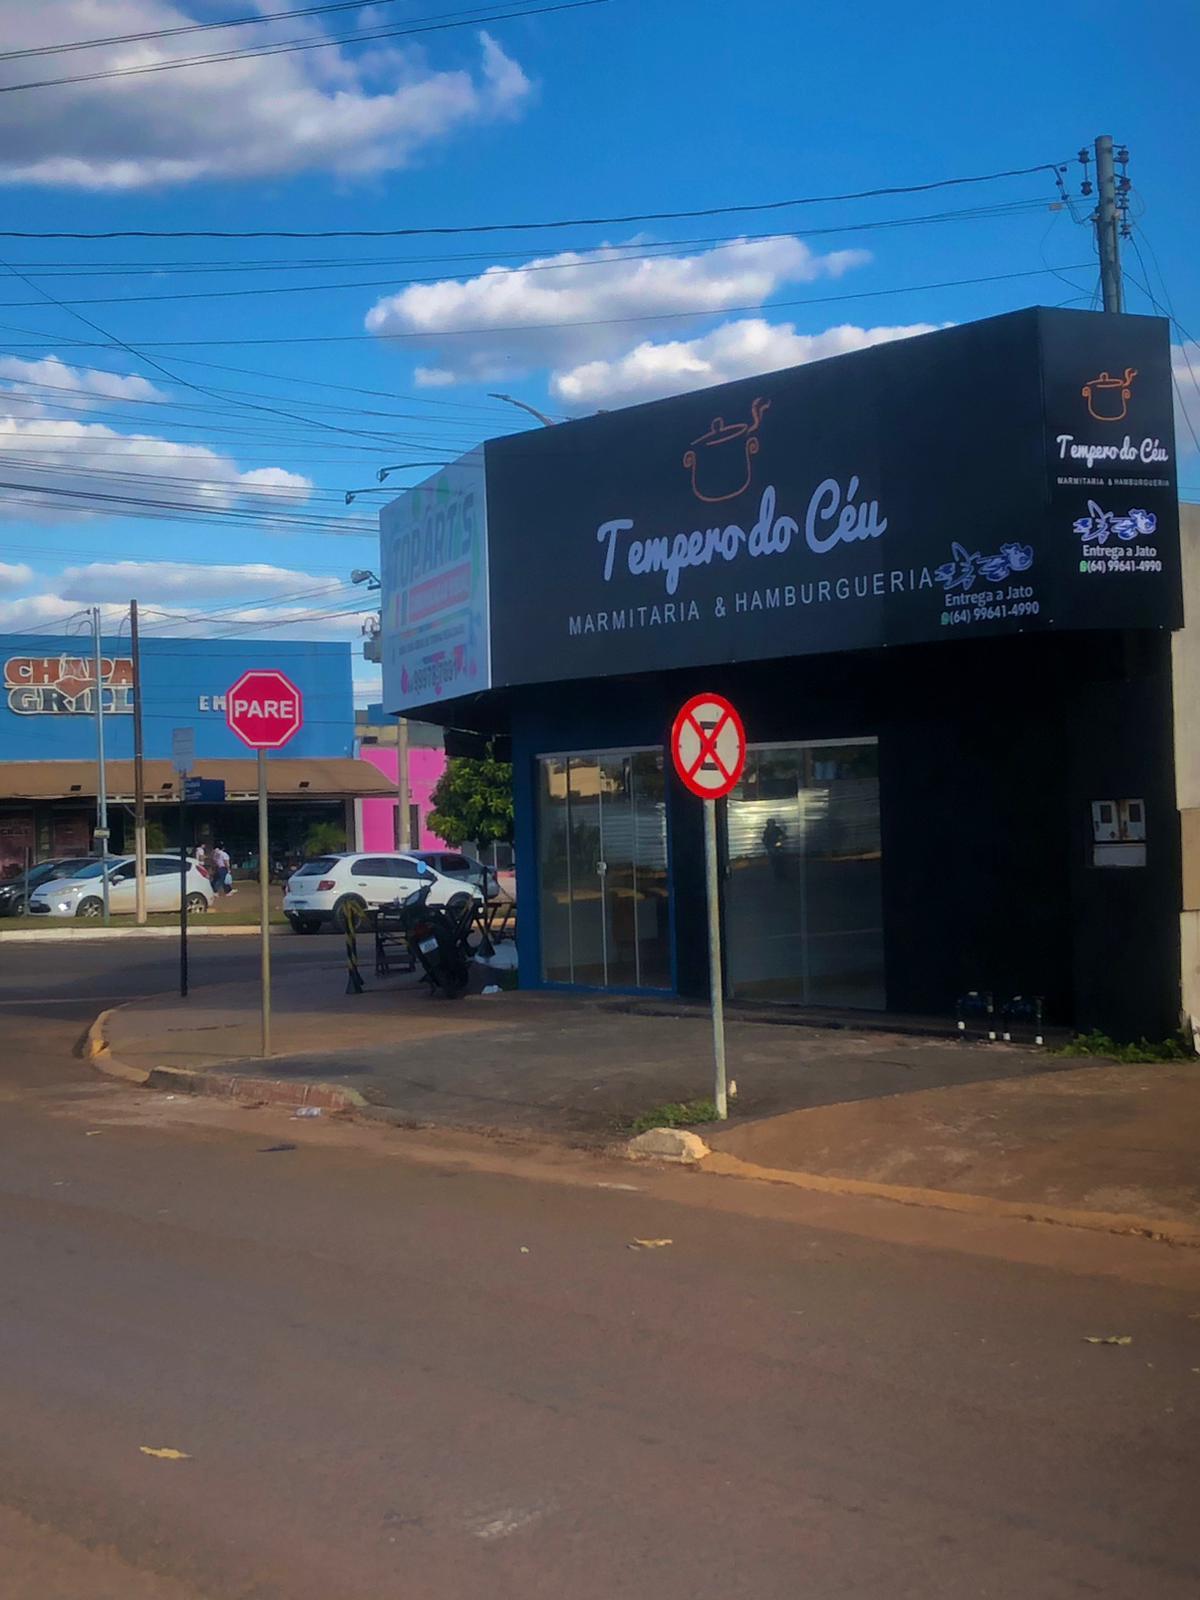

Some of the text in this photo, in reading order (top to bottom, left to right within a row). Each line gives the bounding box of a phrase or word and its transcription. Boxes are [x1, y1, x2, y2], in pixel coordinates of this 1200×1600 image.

[1056, 434, 1169, 468] Tempero do Céu
[1057, 477, 1104, 485] MARMITARIA
[1114, 478, 1170, 486] HAMBURGUERIA
[597, 475, 888, 595] Tempero do Céu
[1083, 545, 1157, 560] Entrega a Jato
[1088, 560, 1162, 573] (64) 99641-4990
[569, 566, 933, 636] MARMITARIA & HAMBURGUERIA
[945, 586, 1033, 607] Entrega a Jato
[950, 601, 1040, 625] (64) 99641-4990
[235, 699, 294, 719] PARE
